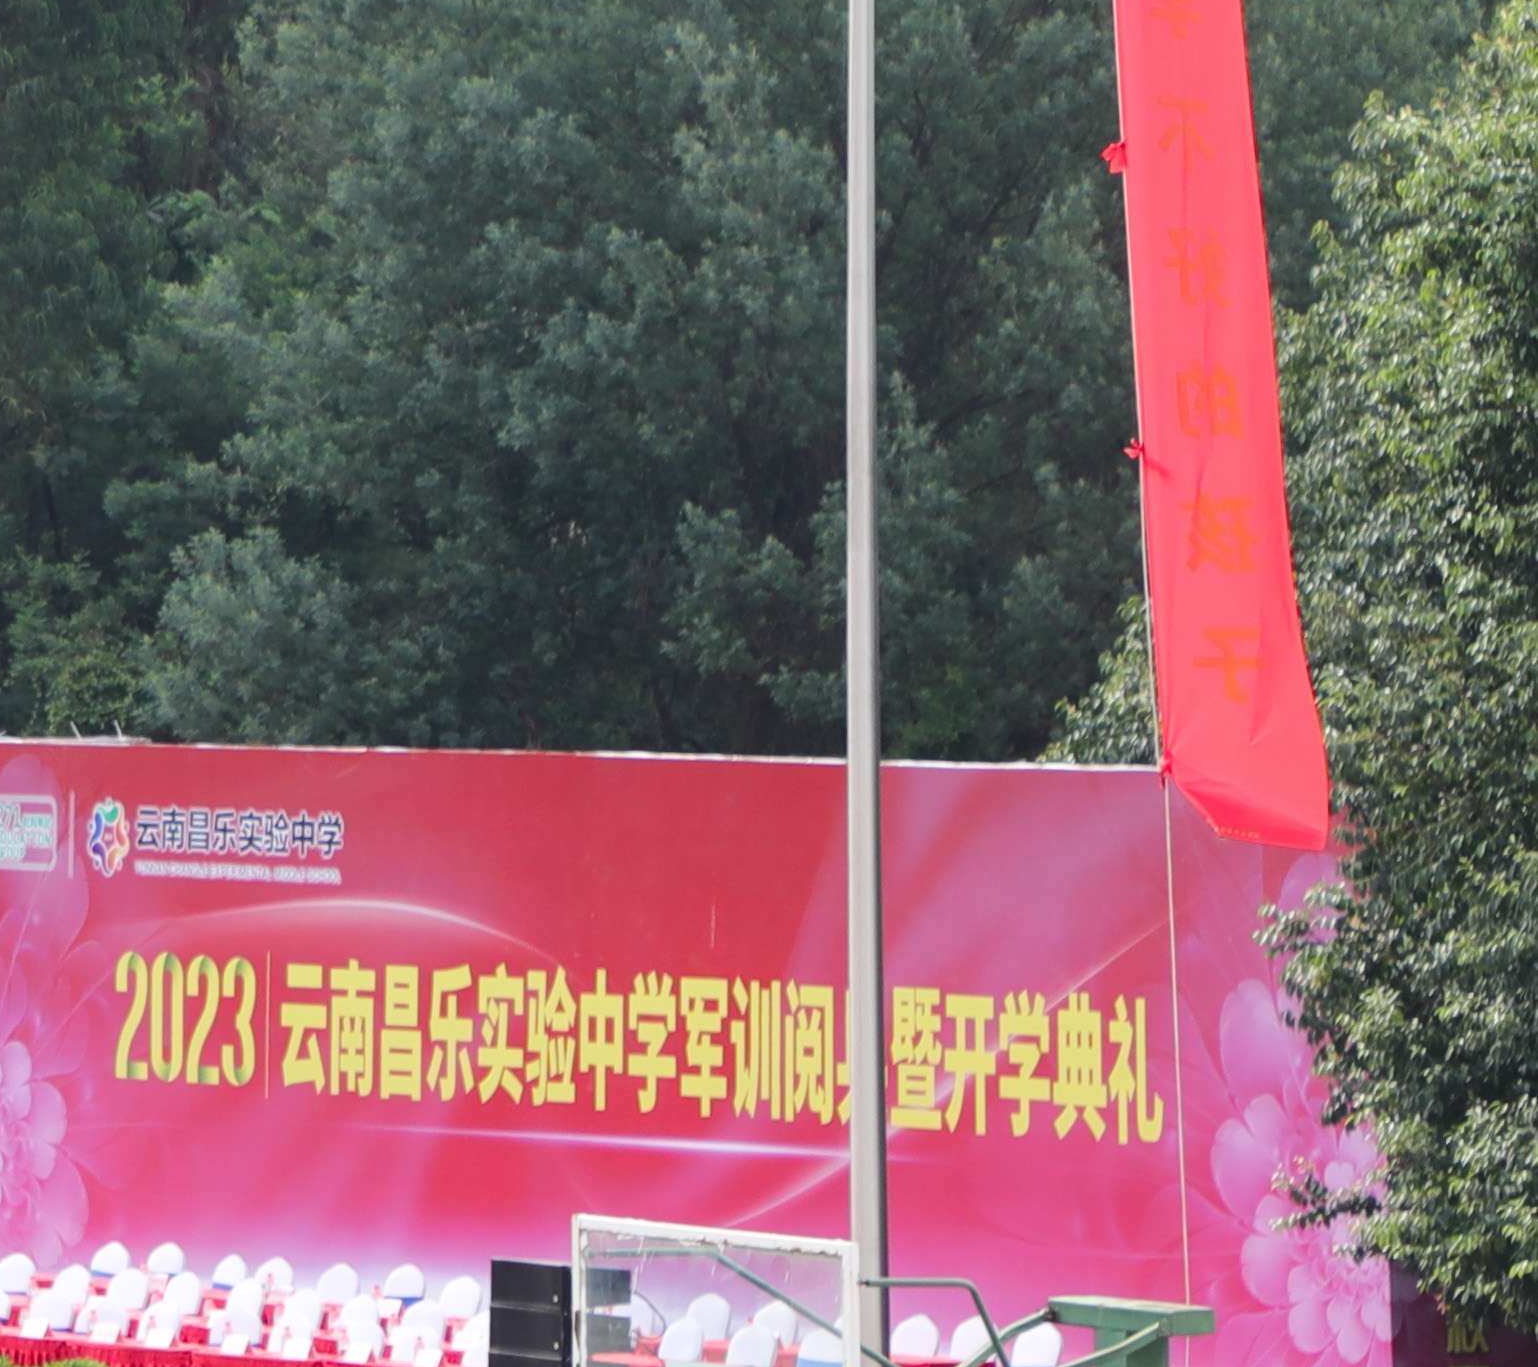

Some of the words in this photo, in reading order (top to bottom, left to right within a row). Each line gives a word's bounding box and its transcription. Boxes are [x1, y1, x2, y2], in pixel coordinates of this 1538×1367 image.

[136, 804, 344, 859] 云南昌乐实验中学
[115, 951, 256, 1086] 2023
[280, 959, 1164, 1145] 云南昌乐实验中学军训阅暨开学典礼
